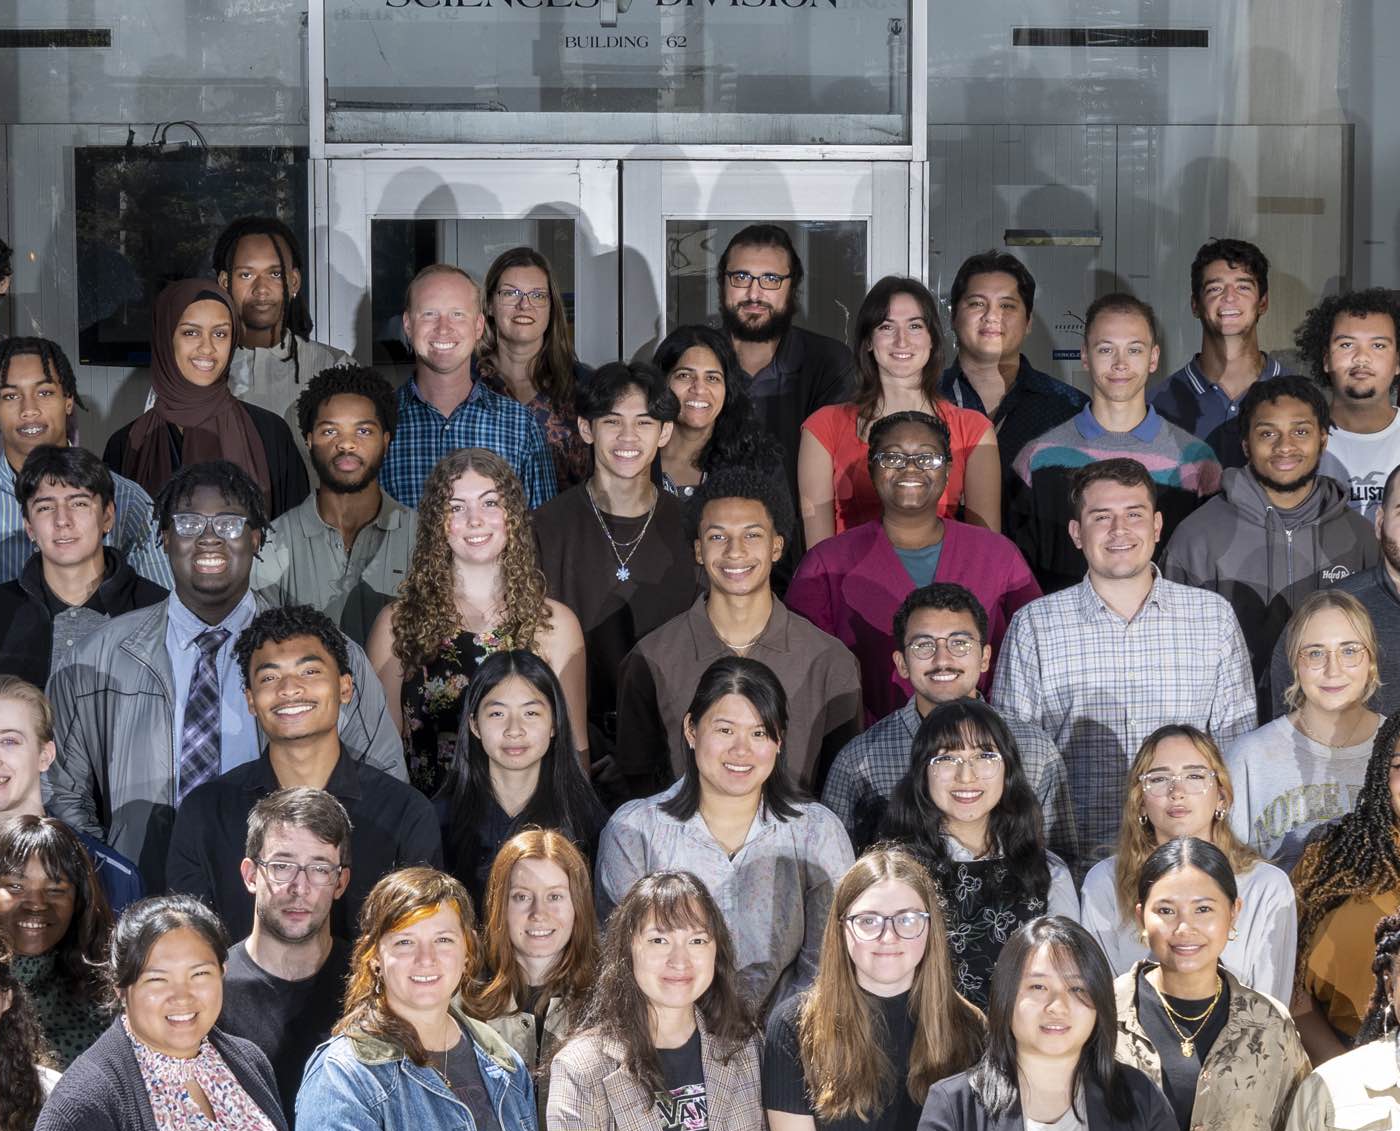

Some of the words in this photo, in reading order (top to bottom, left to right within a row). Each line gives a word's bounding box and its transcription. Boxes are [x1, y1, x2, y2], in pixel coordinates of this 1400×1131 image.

[564, 36, 649, 48] BUILDING
[666, 36, 688, 48] 62
[1322, 569, 1341, 580] Hard
